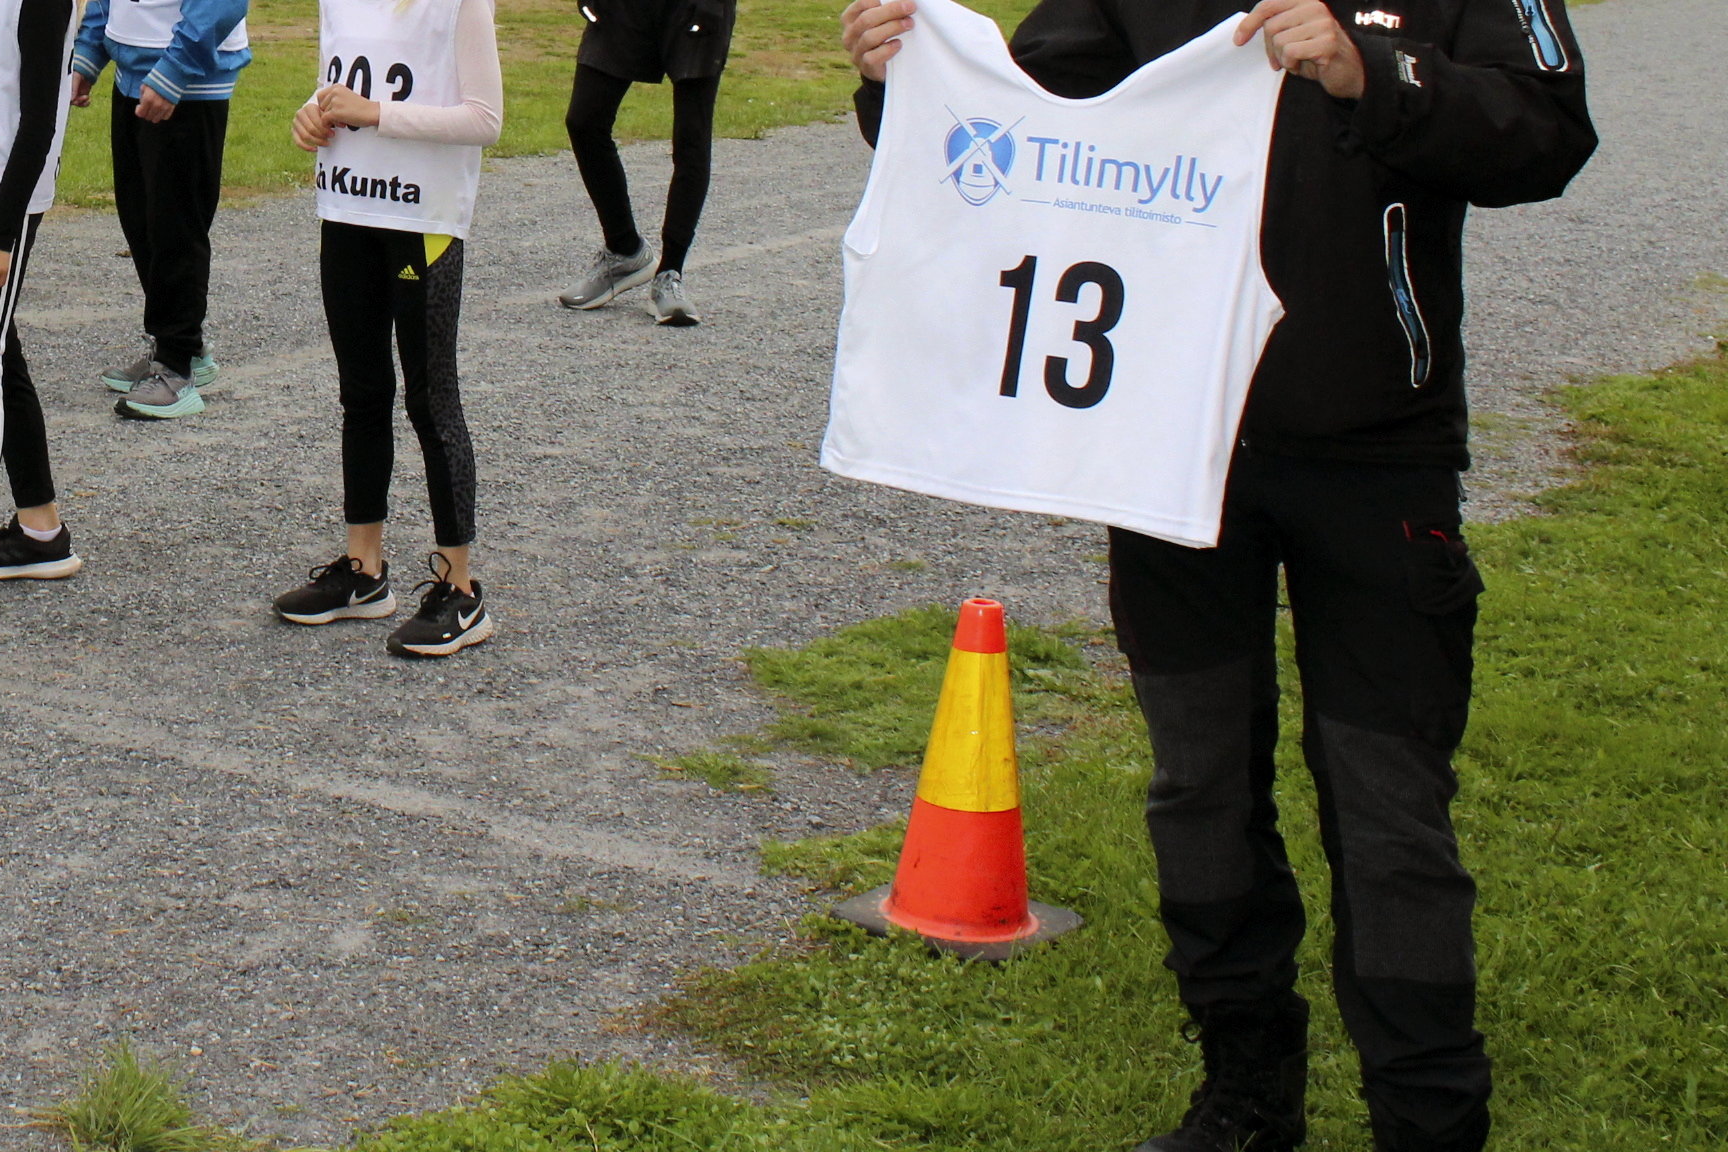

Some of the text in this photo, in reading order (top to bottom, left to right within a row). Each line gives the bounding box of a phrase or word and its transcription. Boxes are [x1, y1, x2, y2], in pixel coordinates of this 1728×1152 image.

[331, 165, 421, 204] Kunta
[1026, 135, 1224, 214] Tilimylly
[1052, 198, 1183, 226] Asiantunteva tilitoimisto
[998, 253, 1126, 410] 13
